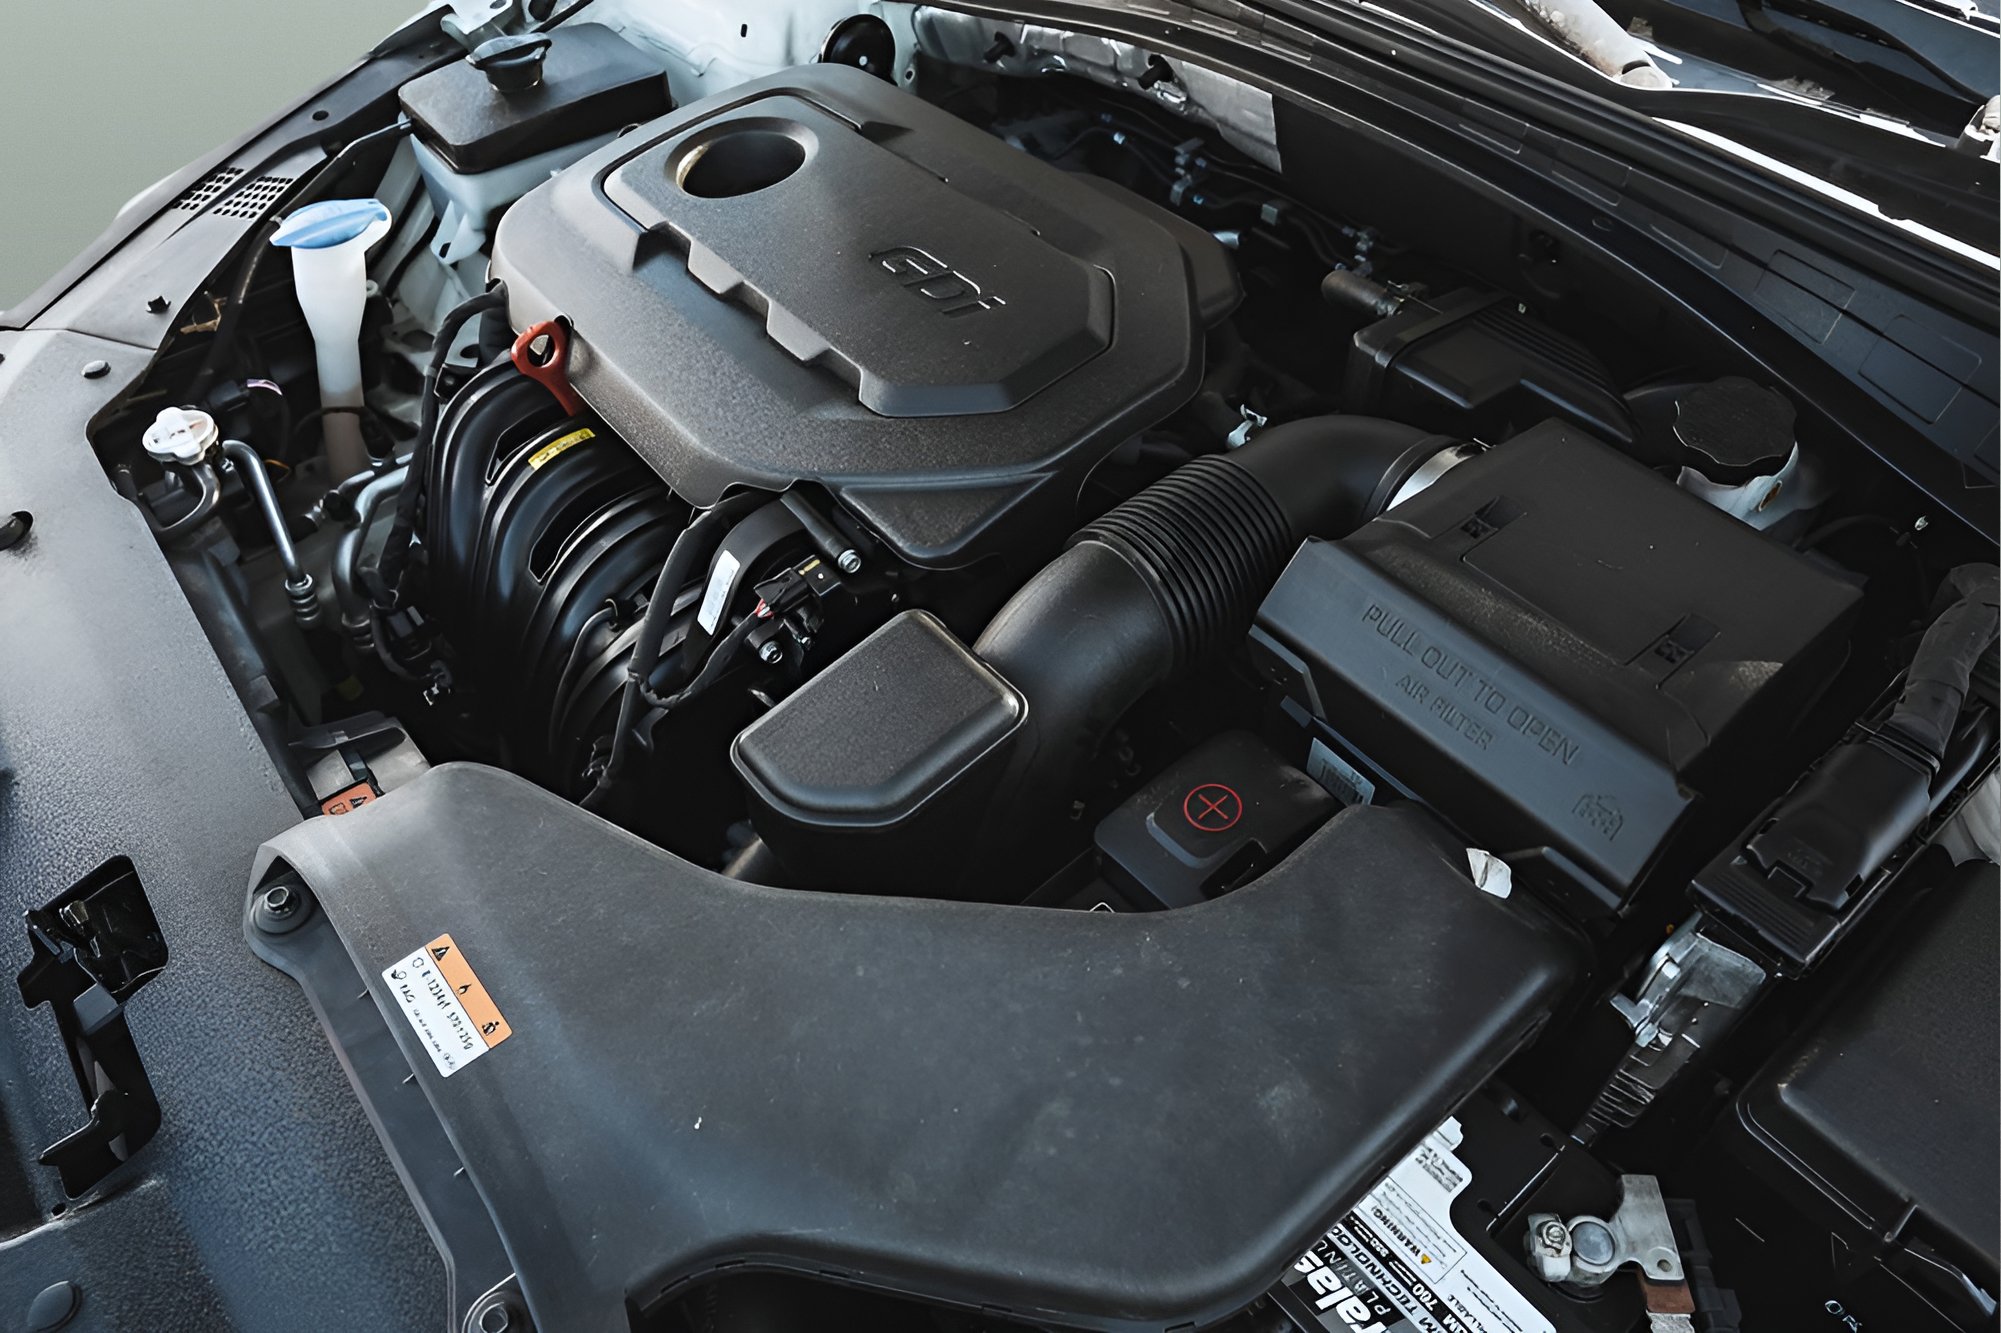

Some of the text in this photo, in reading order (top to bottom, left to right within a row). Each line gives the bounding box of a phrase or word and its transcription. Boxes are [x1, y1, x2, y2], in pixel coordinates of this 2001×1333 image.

[1362, 604, 1579, 765] PULL OUT TO OPEN
[1396, 675, 1494, 750] AIR FILTER
